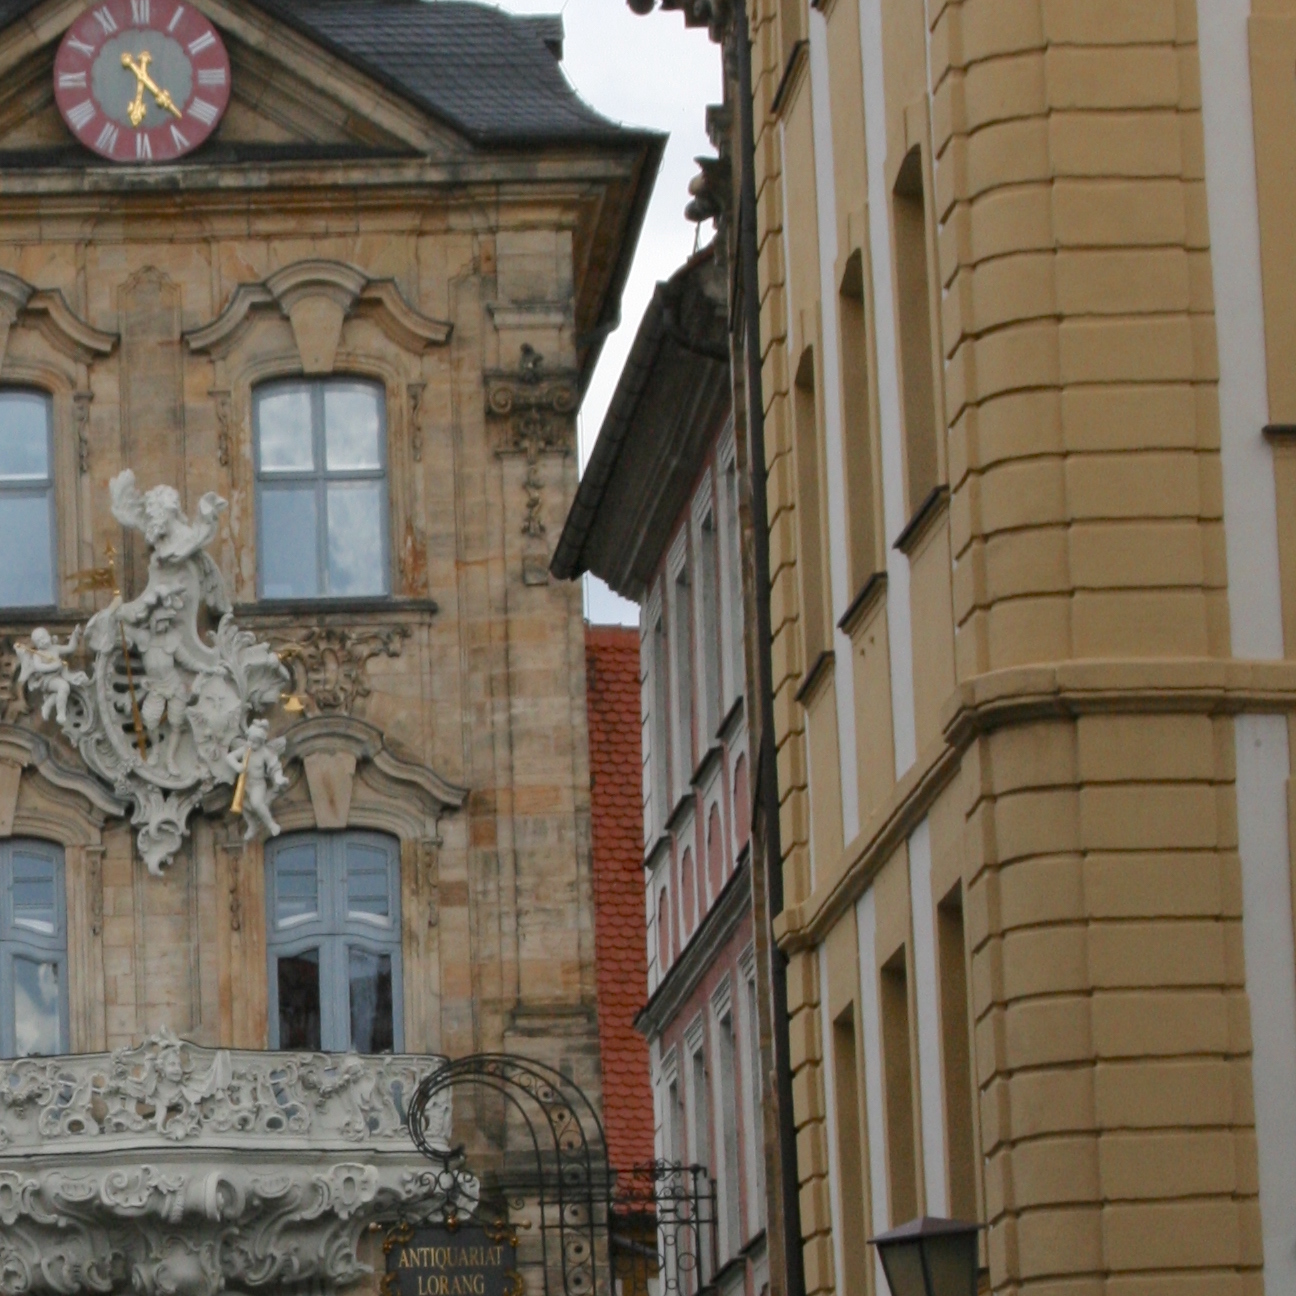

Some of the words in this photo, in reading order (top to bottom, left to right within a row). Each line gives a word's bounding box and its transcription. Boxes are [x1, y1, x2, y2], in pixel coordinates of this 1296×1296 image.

[92, 6, 118, 35] XI
[67, 35, 95, 57] X
[188, 30, 216, 55] II
[58, 71, 87, 88] IX
[197, 68, 226, 85] III
[136, 133, 152, 160] VI
[170, 124, 190, 151] V
[398, 1246, 504, 1270] ANTIQUARIAT
[418, 1274, 484, 1296] LORANG
